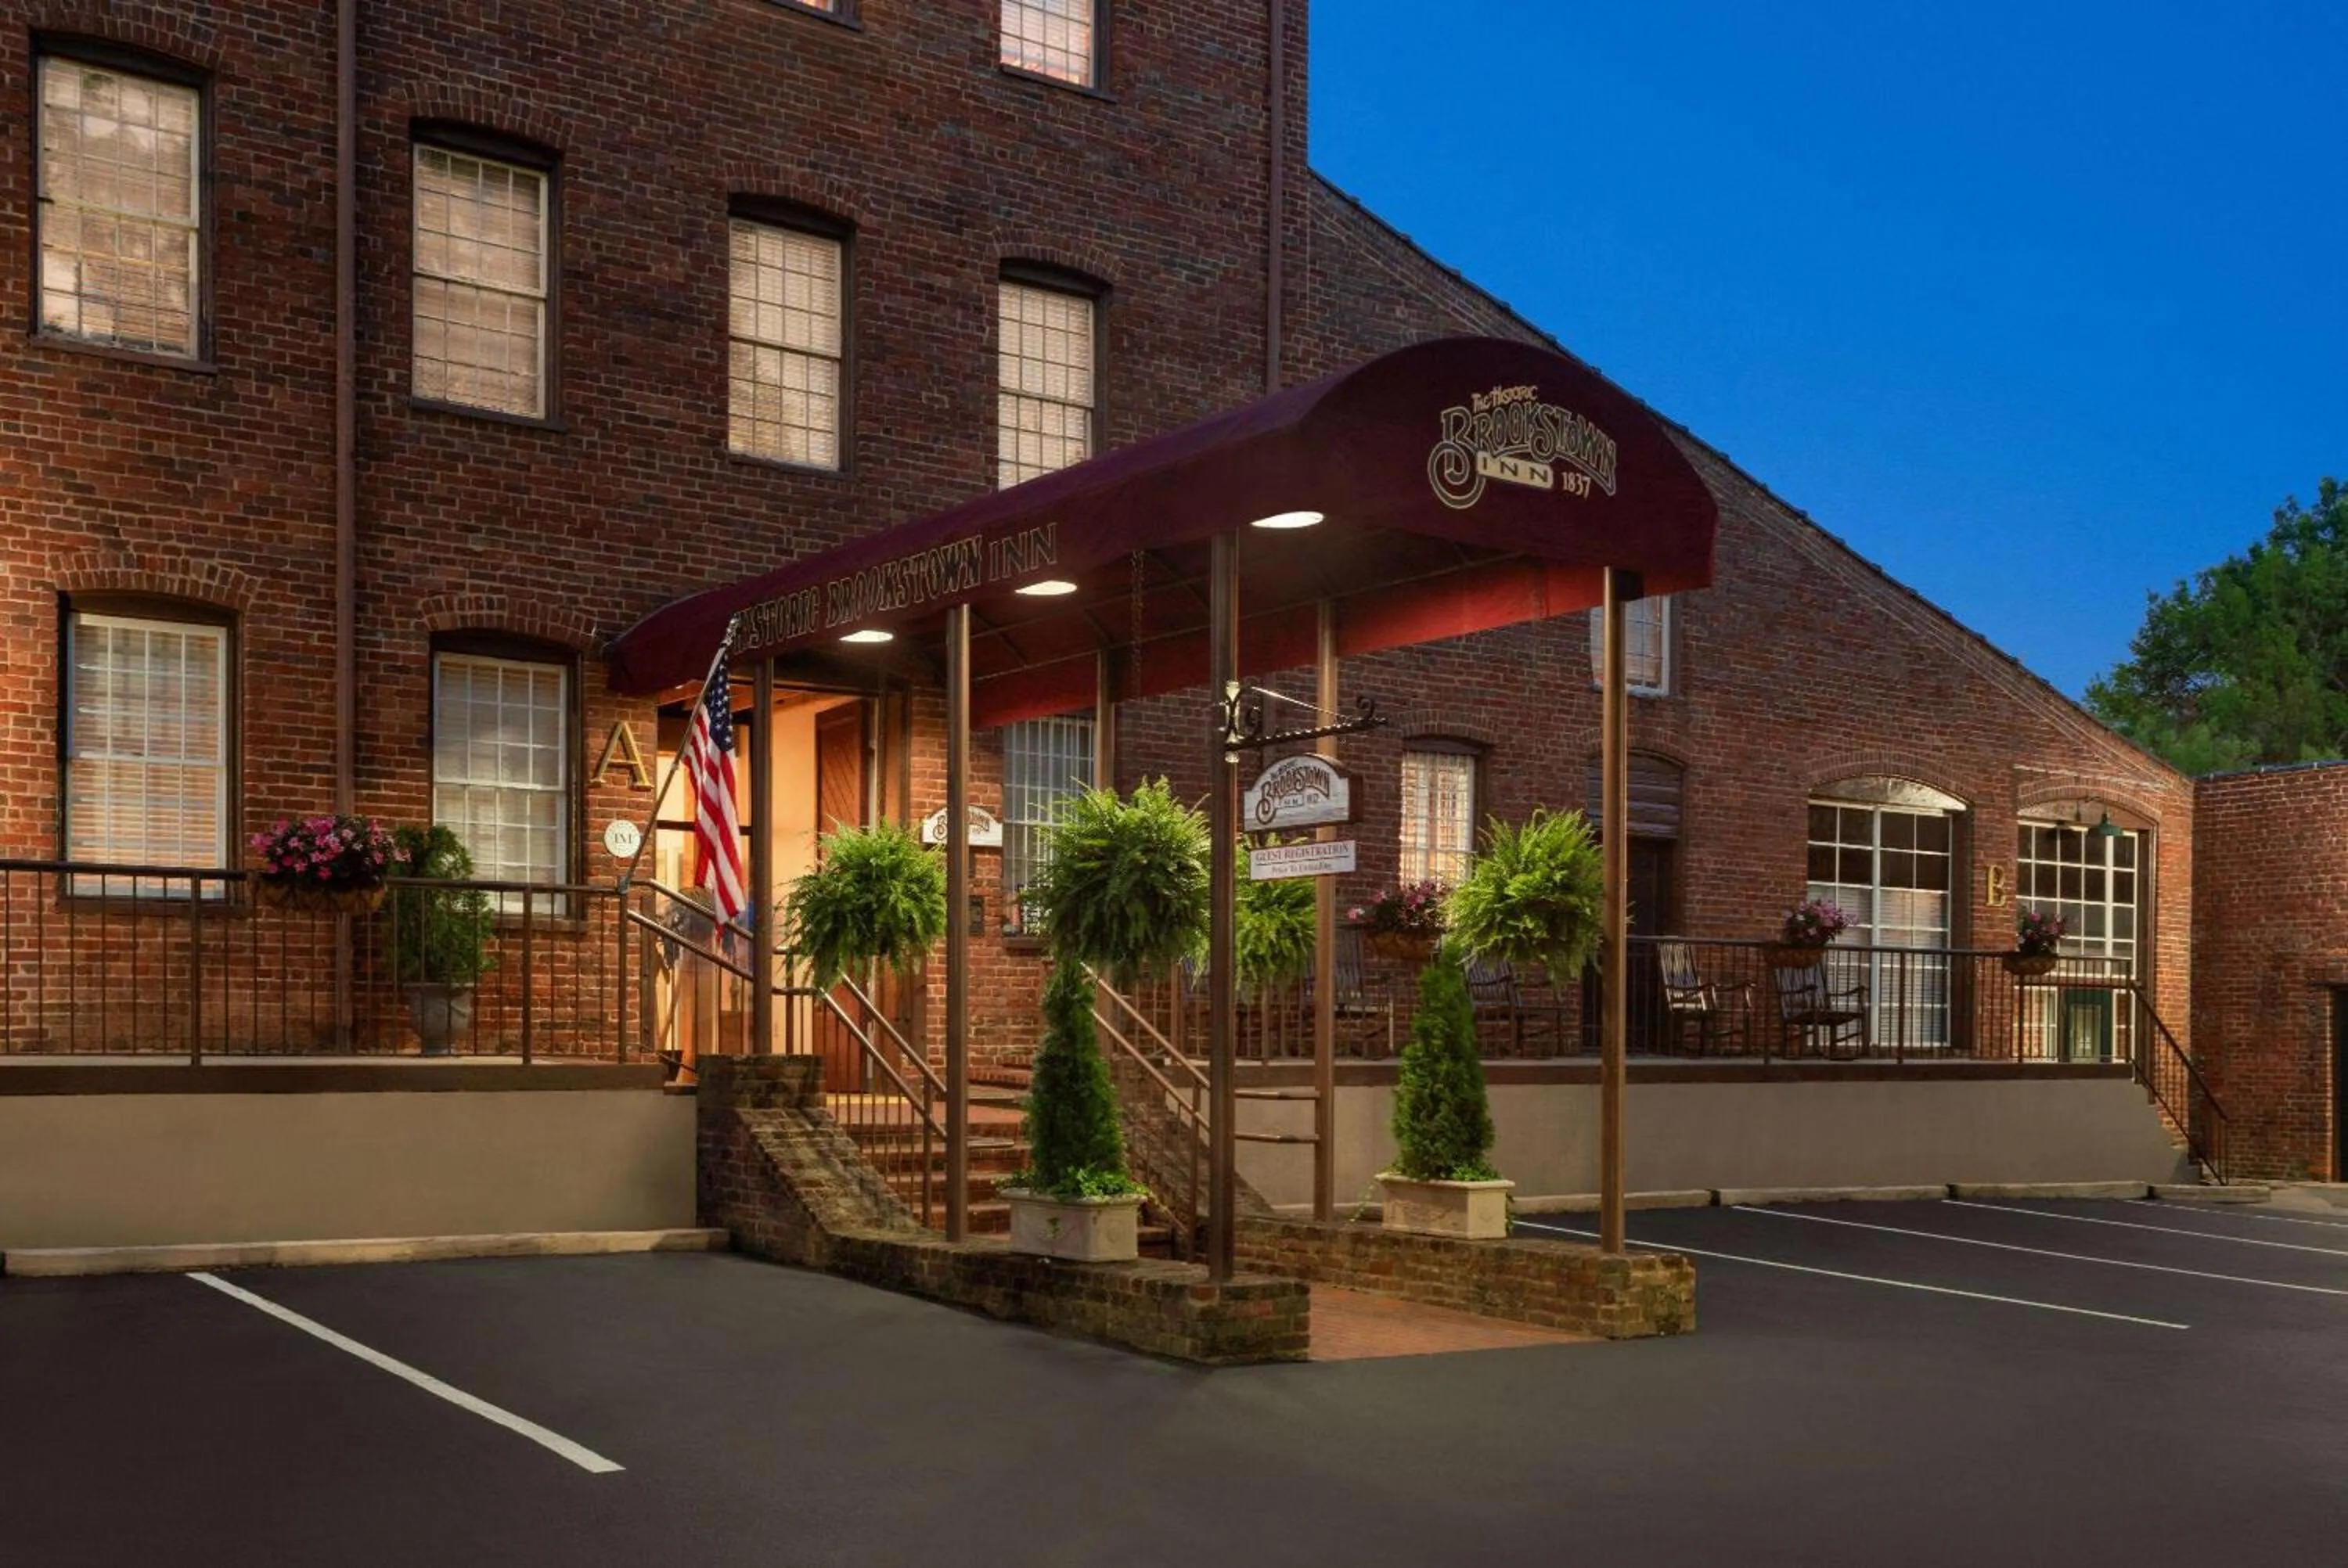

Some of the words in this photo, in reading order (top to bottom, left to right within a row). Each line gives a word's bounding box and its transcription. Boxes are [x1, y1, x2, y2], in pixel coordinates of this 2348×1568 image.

[1428, 402, 1617, 509] BROOKSTOWN
[1481, 459, 1549, 483] INN
[1561, 472, 1591, 499] 1837
[826, 534, 982, 628] BROOKSTOWN
[989, 523, 1058, 581] INN
[589, 721, 654, 792] A
[1986, 865, 2006, 907] B
